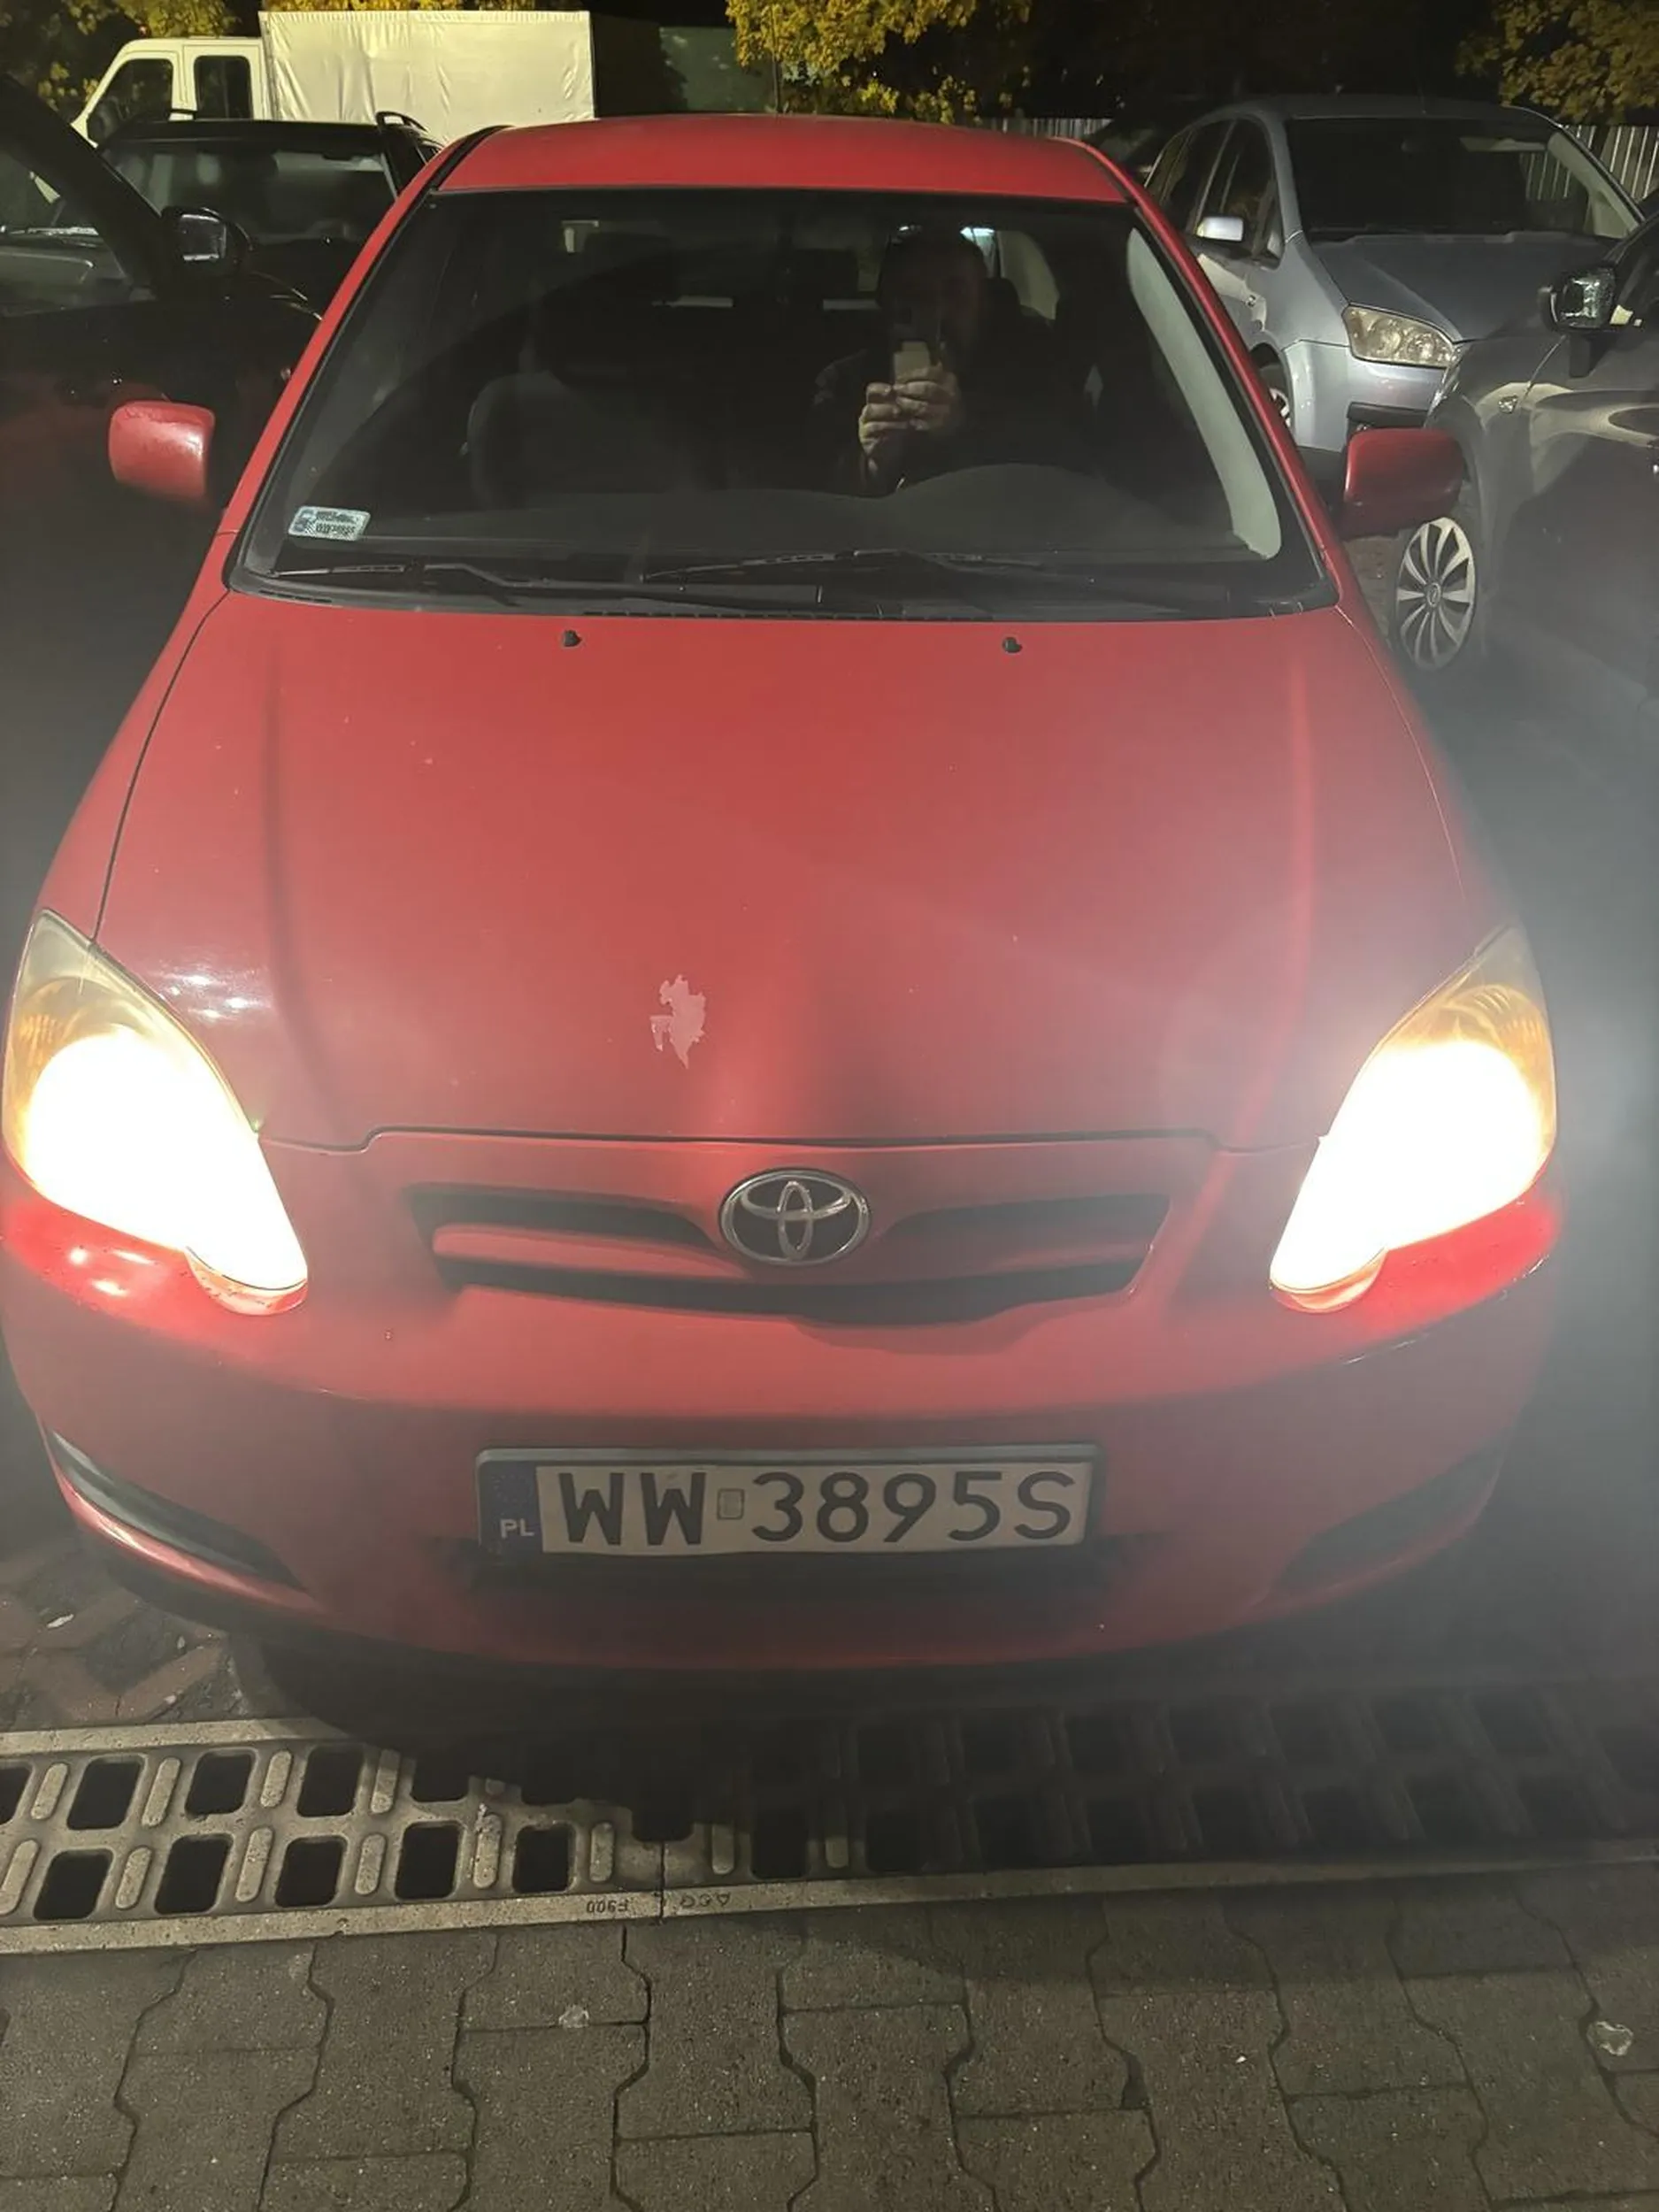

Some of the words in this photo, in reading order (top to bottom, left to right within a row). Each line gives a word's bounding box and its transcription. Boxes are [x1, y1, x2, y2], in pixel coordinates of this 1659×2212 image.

[558, 1471, 706, 1547] WW
[751, 1470, 1076, 1543] 3895S
[499, 1518, 535, 1539] PL
[586, 1899, 629, 1914] F900
